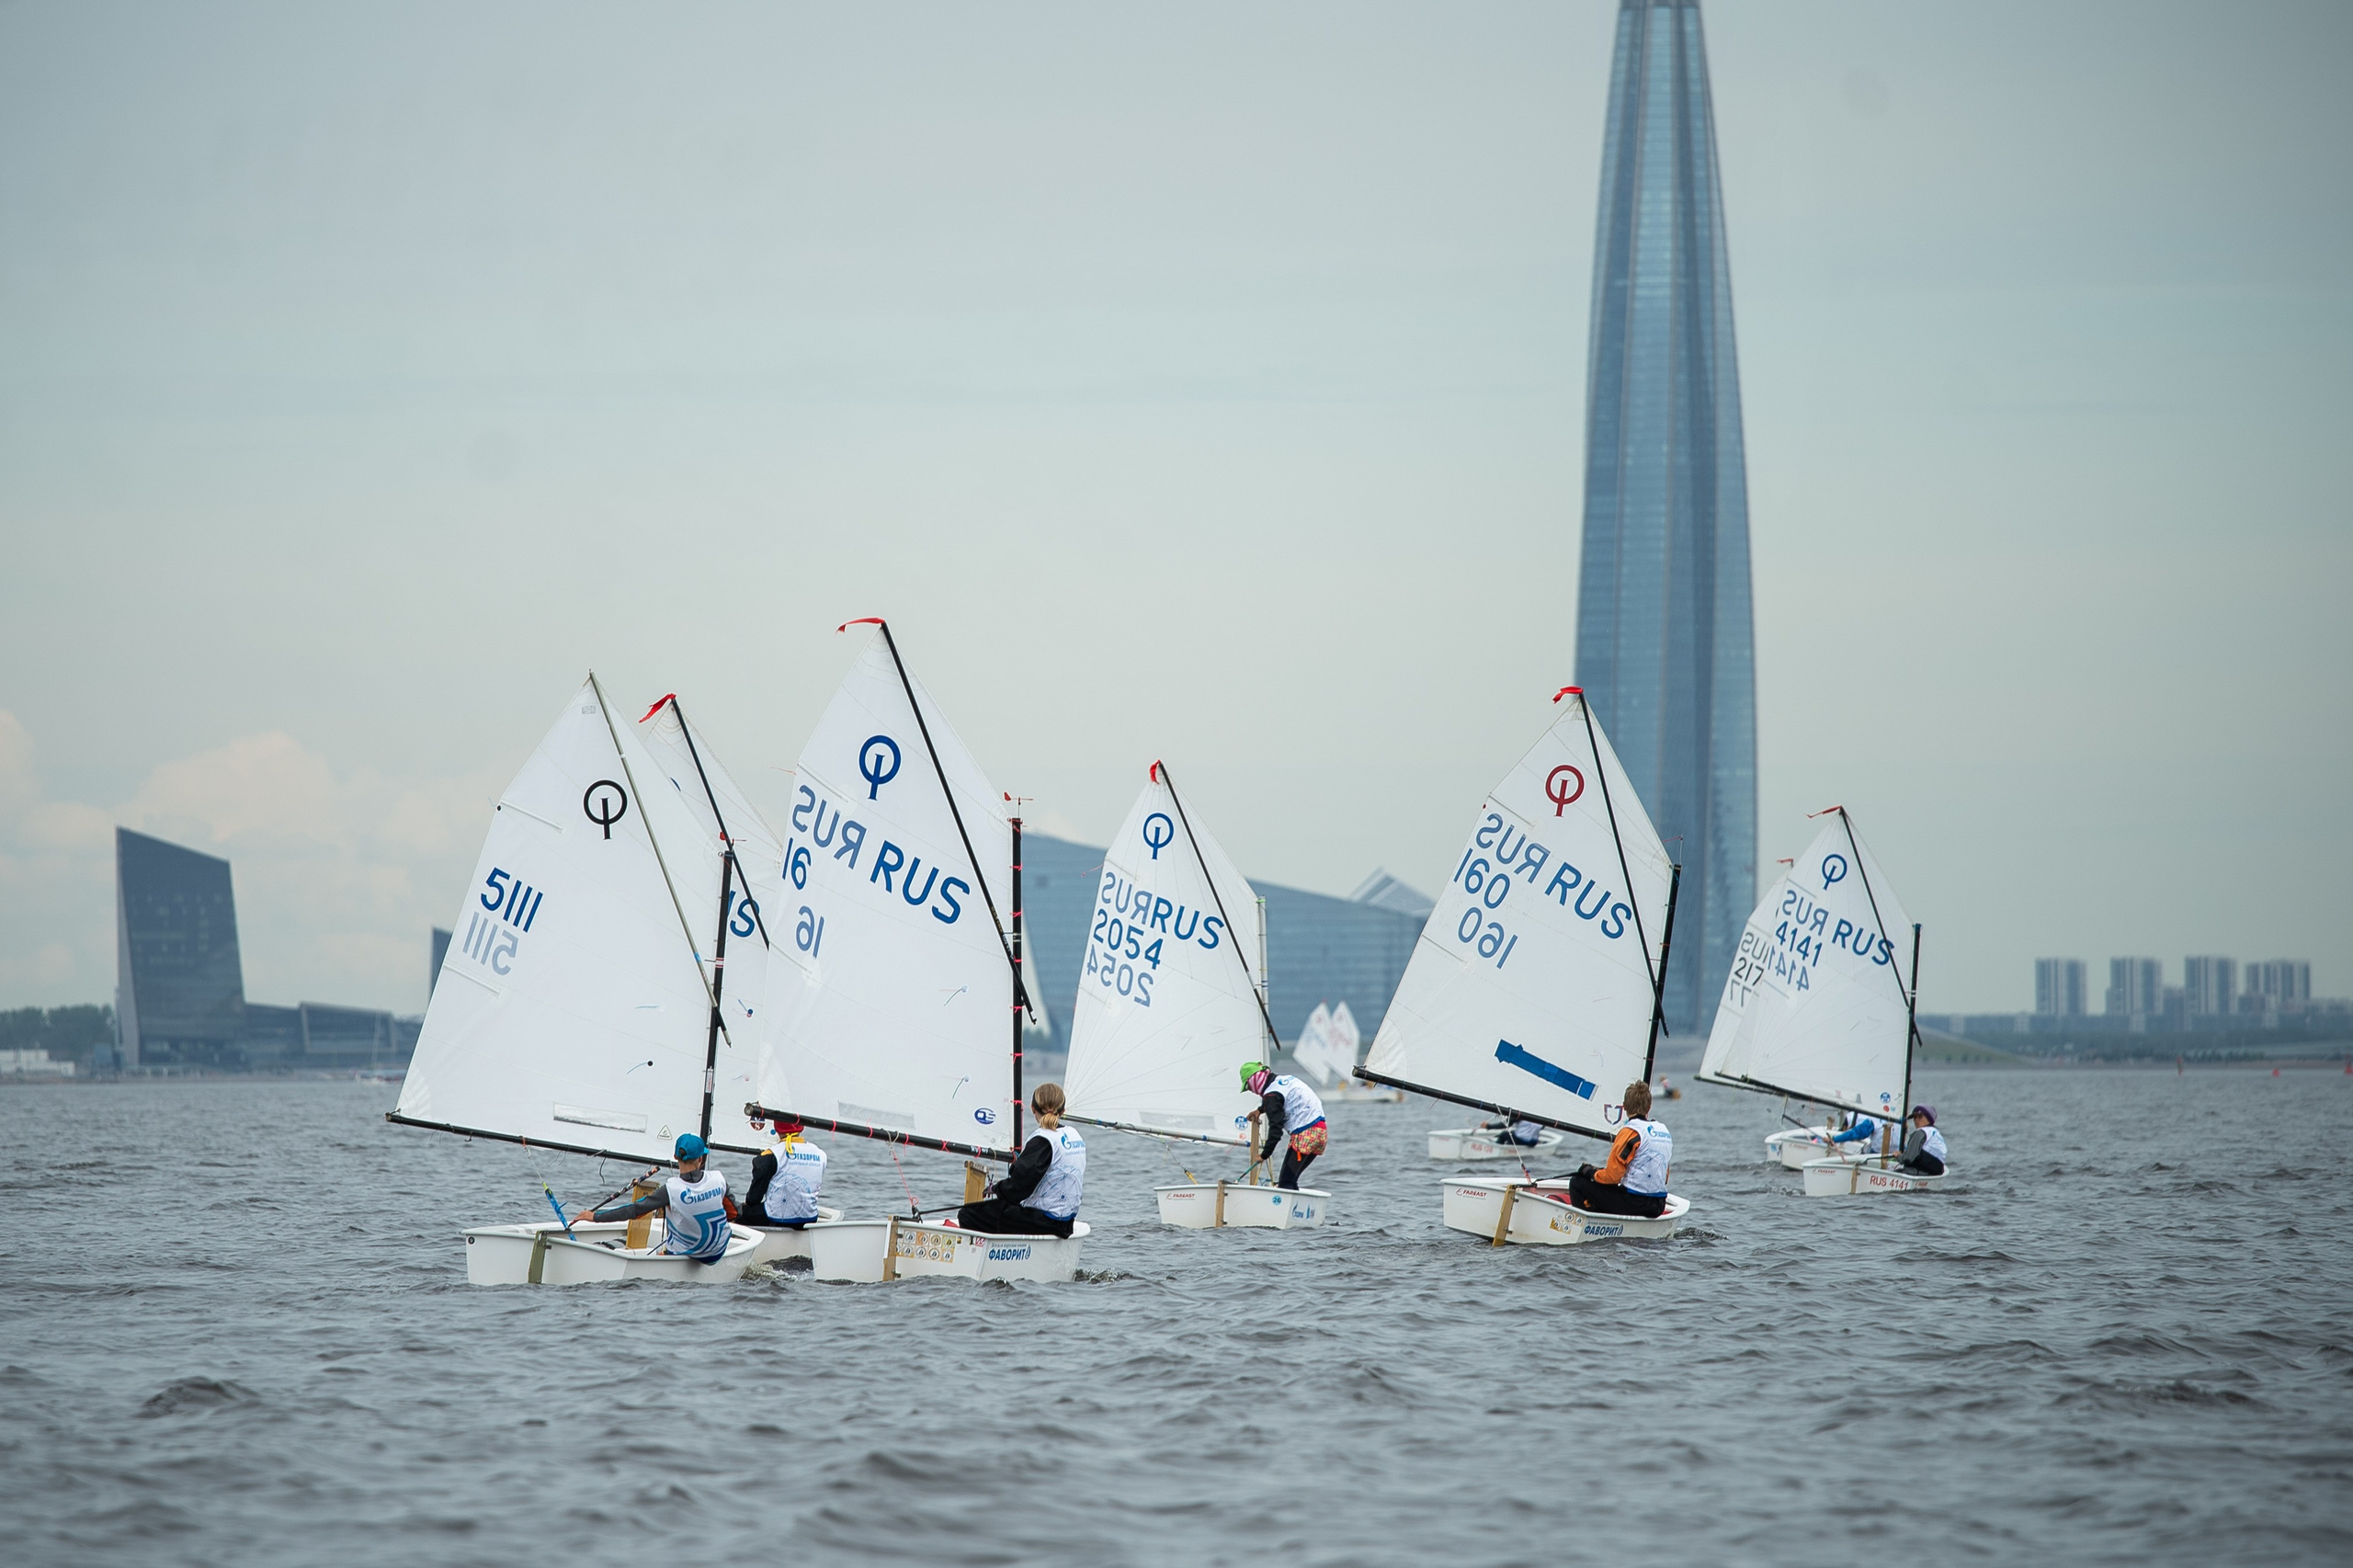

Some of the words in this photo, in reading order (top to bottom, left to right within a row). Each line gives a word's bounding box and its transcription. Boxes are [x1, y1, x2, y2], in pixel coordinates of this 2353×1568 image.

[480, 867, 544, 933] 5111
[870, 840, 971, 925] RUS
[1453, 847, 1511, 910] 160
[1544, 861, 1632, 939] RUS
[1093, 908, 1164, 971] 2054
[1150, 896, 1225, 949] RUS
[1775, 920, 1823, 968] 4141
[1831, 918, 1895, 966] RUS
[1870, 1175, 1887, 1187] RUS
[1889, 1177, 1909, 1191] 4141
[988, 1248, 1027, 1261] ФАВОРИТ
[1584, 1224, 1620, 1236] ФАВОРИТ
